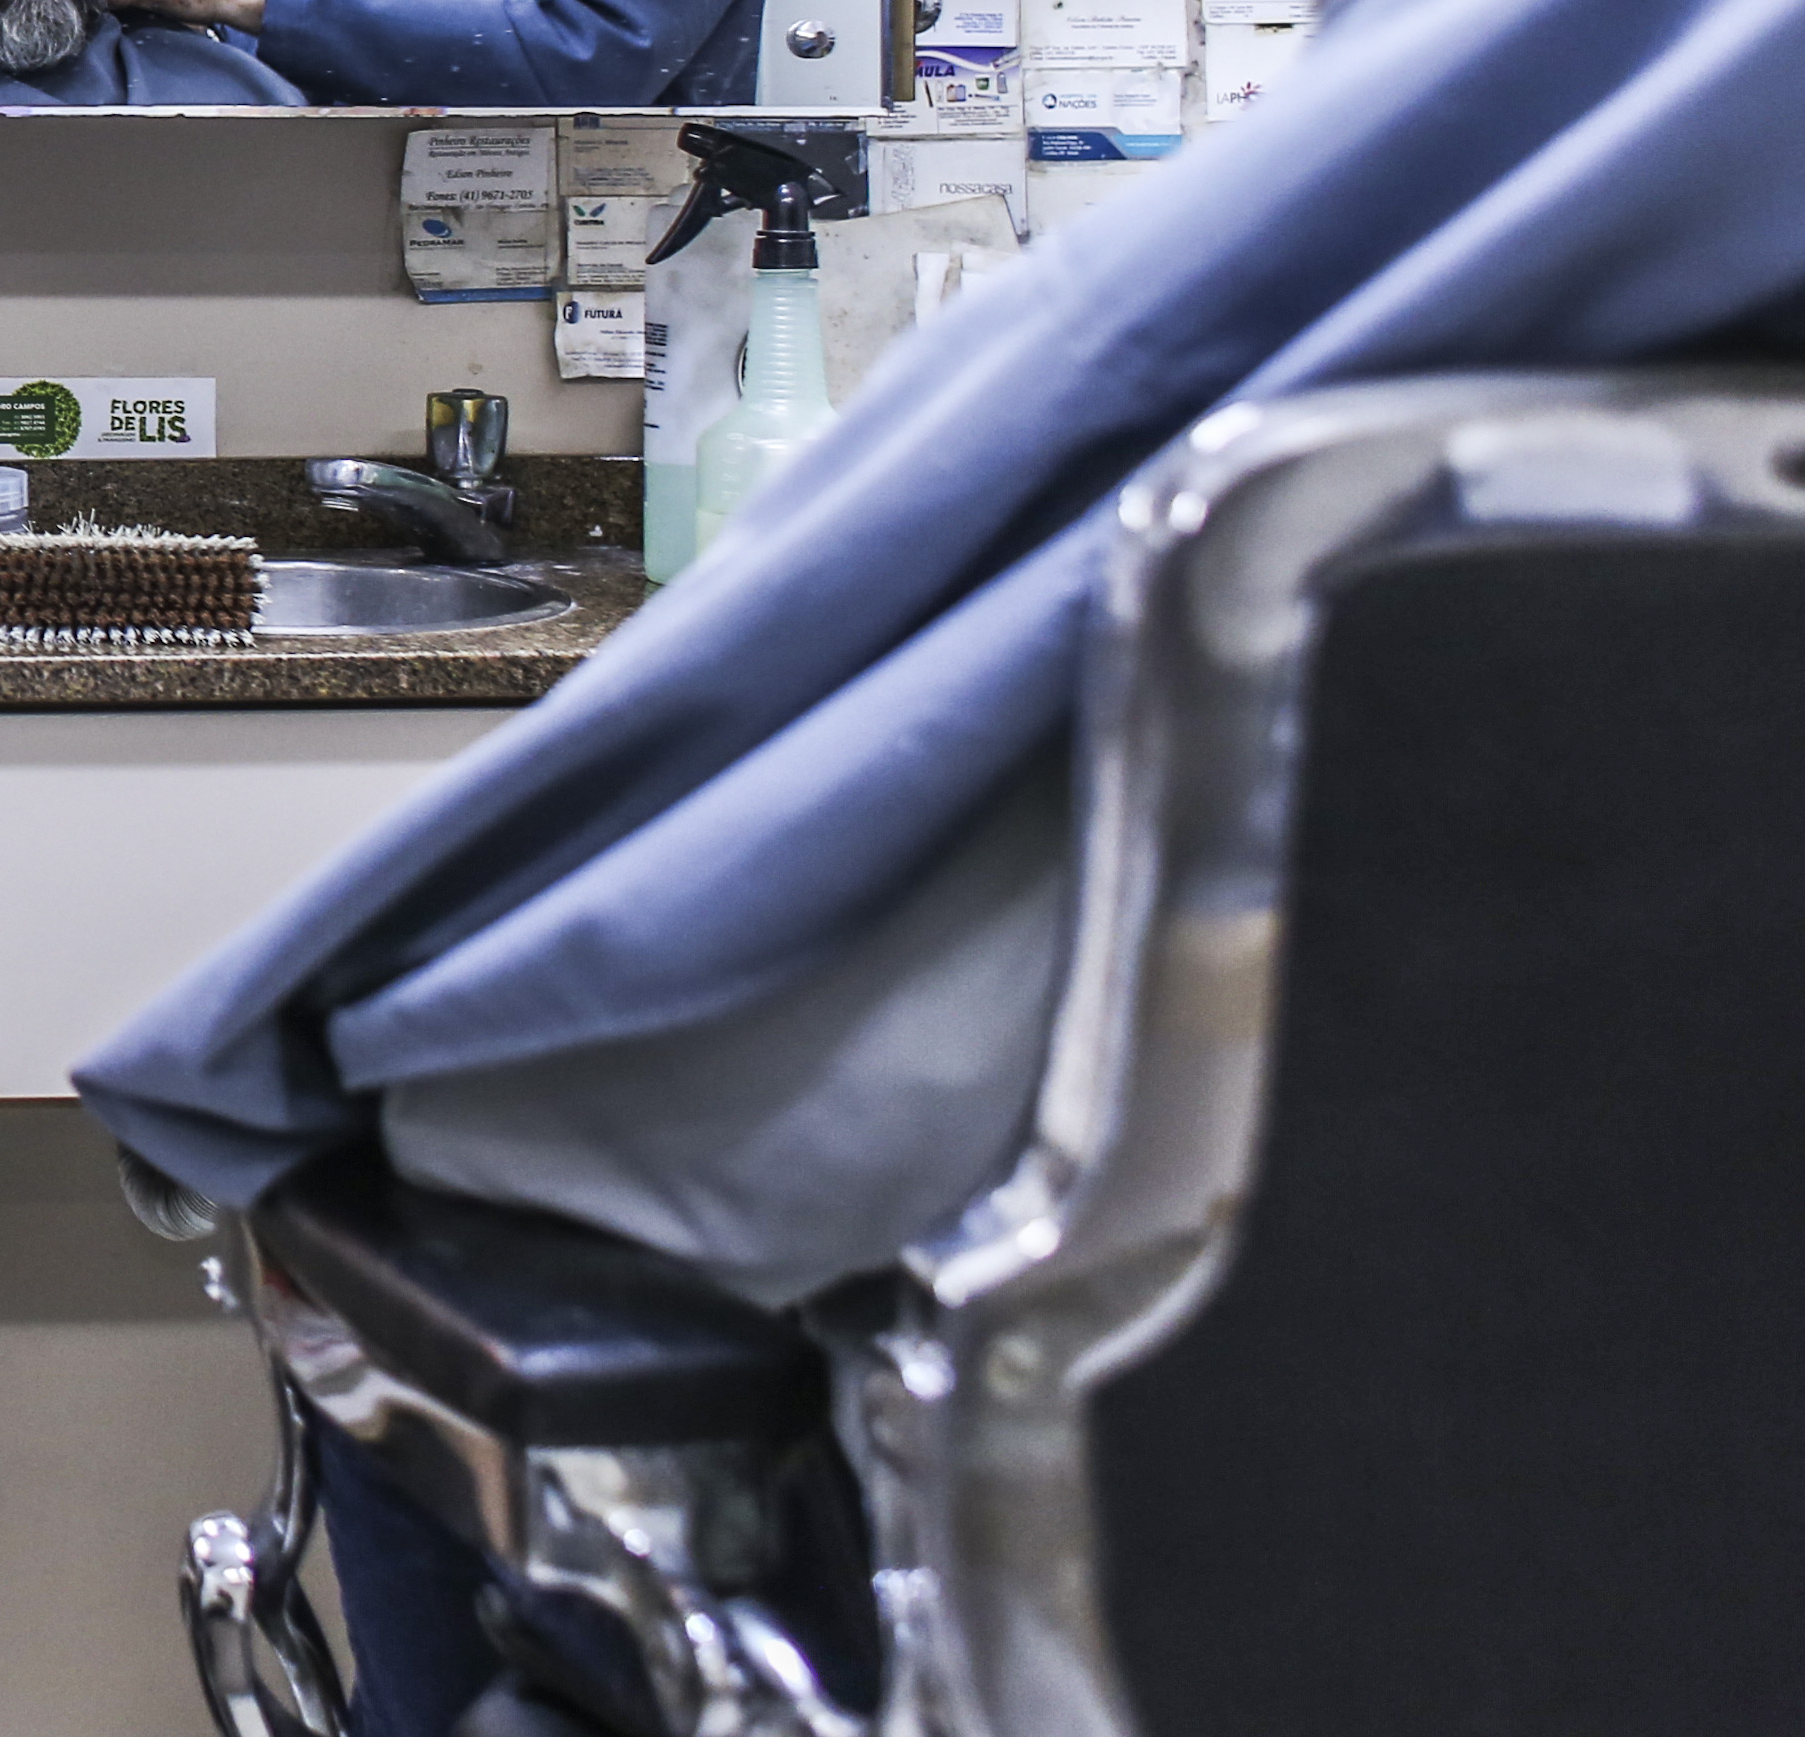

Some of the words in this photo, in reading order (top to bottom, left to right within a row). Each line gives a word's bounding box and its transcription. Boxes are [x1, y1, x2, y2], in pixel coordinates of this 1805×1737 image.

[1059, 97, 1097, 110] NAÇÕES
[939, 182, 1013, 195] nossacasa
[459, 190, 479, 202] (41)
[480, 190, 533, 201] 9671-2705
[409, 238, 464, 247] PEDRAMAR
[584, 308, 623, 319] FUTURA
[13, 402, 46, 410] CAMPOS
[110, 399, 185, 415] FLORES
[110, 416, 136, 432] DE
[138, 415, 189, 443] LIS
